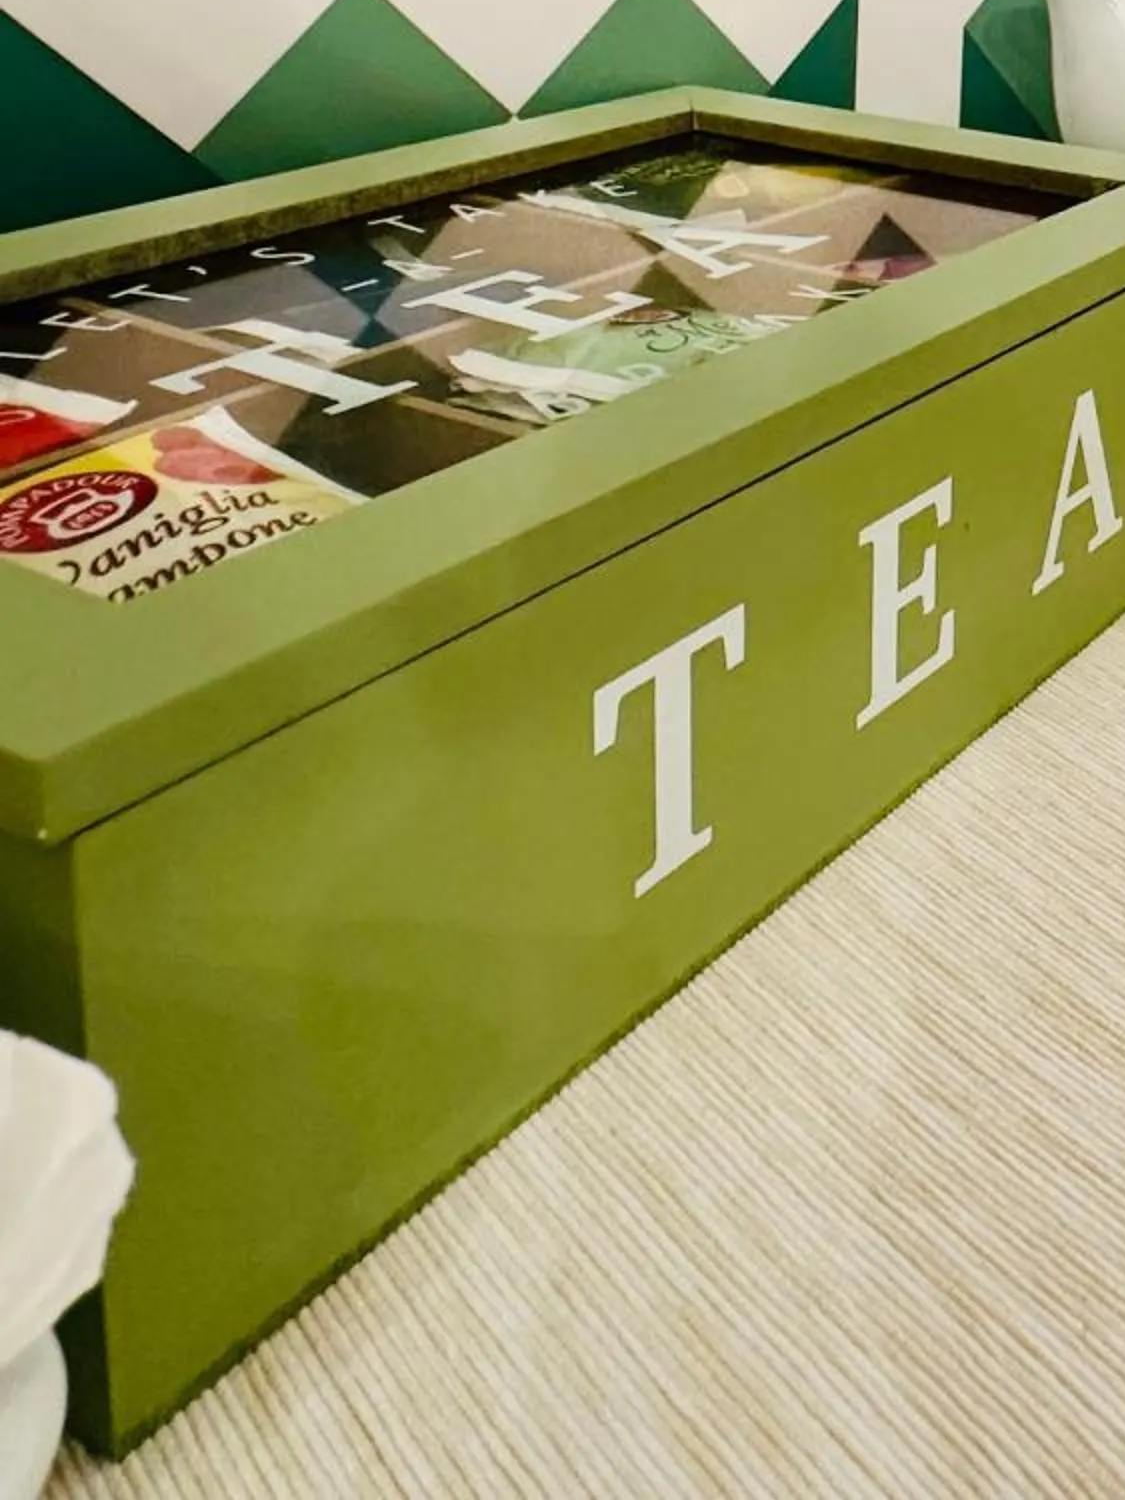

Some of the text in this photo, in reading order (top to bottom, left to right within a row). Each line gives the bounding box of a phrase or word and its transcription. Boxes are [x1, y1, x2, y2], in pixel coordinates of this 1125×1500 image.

[0, 177, 639, 362] LET'S TAKE
[149, 222, 831, 416] TEA
[107, 509, 319, 604] ampone
[592, 388, 1125, 900] TEA
